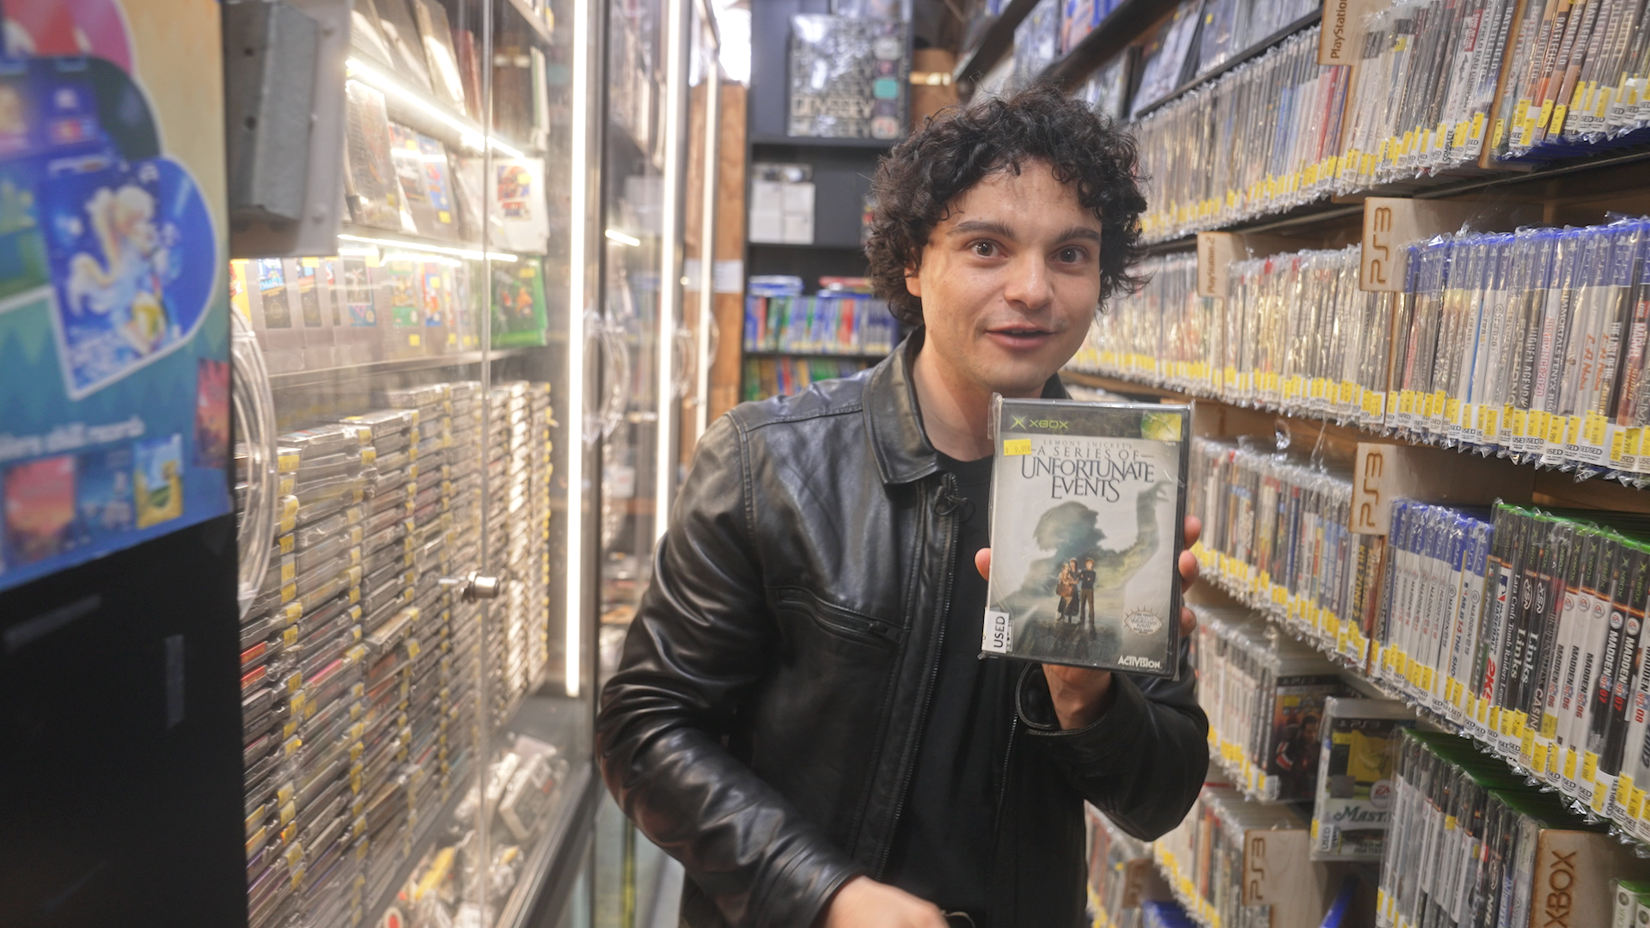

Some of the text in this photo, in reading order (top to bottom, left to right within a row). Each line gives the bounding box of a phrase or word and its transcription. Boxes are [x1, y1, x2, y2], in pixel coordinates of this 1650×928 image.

[1491, 6, 1514, 69] BATTLEFIELD
[1545, 16, 1566, 73] BATTLEFIELD
[1558, 9, 1582, 65] BATTLEFIELD
[1574, 2, 1598, 60] BATTLEFIELD
[1369, 207, 1392, 284] PS3
[1554, 294, 1570, 356] IMMORTALS
[1629, 323, 1645, 358] MARVEL
[1607, 336, 1619, 357] LAST
[1549, 356, 1561, 391] FENYX
[1029, 419, 1069, 430] XBOX
[1037, 446, 1139, 460] A SERIES OF
[1043, 439, 1132, 449] LEMONY SNICKET'S
[1022, 455, 1155, 483] UNFORTUNATE
[1051, 475, 1121, 503] EVENTS
[1359, 452, 1383, 528] PS3
[1354, 545, 1365, 608] KILLZONE
[1512, 573, 1521, 595] Lara
[1570, 554, 1578, 581] XBOX
[1586, 555, 1594, 581] XBOX
[1618, 570, 1626, 598] XBOX
[1459, 595, 1467, 620] MLB
[1465, 604, 1477, 638] MADDEN
[1509, 595, 1518, 620] Croft
[993, 616, 1006, 649] USED
[1505, 622, 1514, 647] Tomb
[1117, 655, 1161, 669] ACTIVISION
[1450, 655, 1458, 677] SHO
[1511, 628, 1526, 679] Links
[1521, 632, 1538, 684] Links
[1552, 644, 1564, 684] MADDEN
[1566, 645, 1580, 686] MADDEN
[1602, 630, 1619, 677] MADDEN
[1618, 636, 1635, 684] MADDEN
[1580, 652, 1594, 694] MADDEN
[1547, 695, 1556, 708] 06
[1562, 696, 1571, 710] 06
[1575, 705, 1584, 719] 06
[1598, 688, 1608, 704] 07
[1613, 696, 1624, 712] 07
[1634, 708, 1645, 724] 08
[1605, 779, 1619, 816] COMPLETE
[1250, 837, 1266, 900] PS3
[1543, 851, 1577, 928] XBOX
